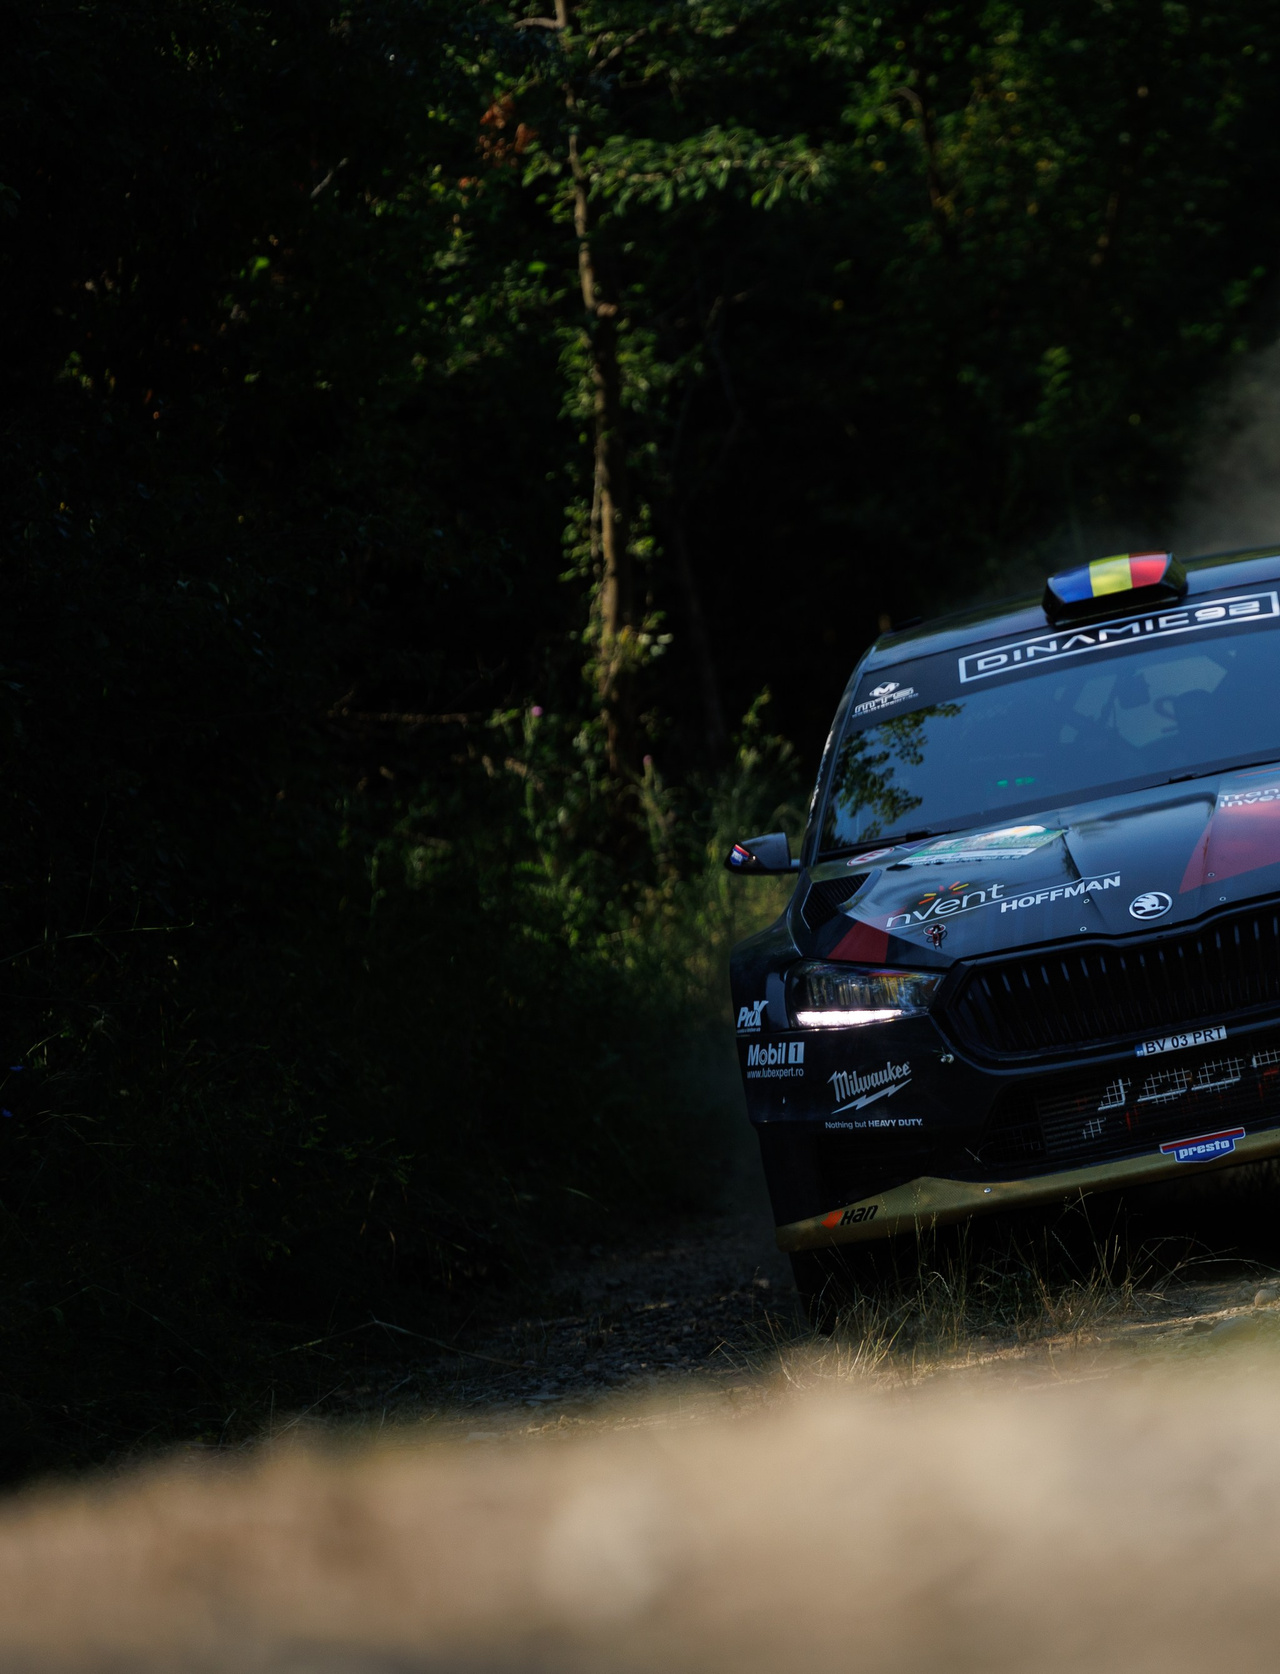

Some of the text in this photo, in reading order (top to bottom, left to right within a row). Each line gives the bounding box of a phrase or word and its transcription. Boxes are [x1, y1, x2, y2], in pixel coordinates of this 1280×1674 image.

[977, 600, 1260, 671] DINAMIC92
[1000, 875, 1121, 914] HOFFMAN
[1145, 1038, 1166, 1054] BV
[1171, 1034, 1188, 1048] 03
[1192, 1026, 1223, 1044] PRT
[747, 1041, 805, 1067] Mobil 1
[746, 1066, 805, 1080] www.lubexpert.ro
[826, 1061, 912, 1103] Milwaukee
[825, 1121, 853, 1130] Nothing
[854, 1120, 867, 1128] but
[868, 1119, 897, 1127] HEAVY
[1179, 1140, 1230, 1160] presto
